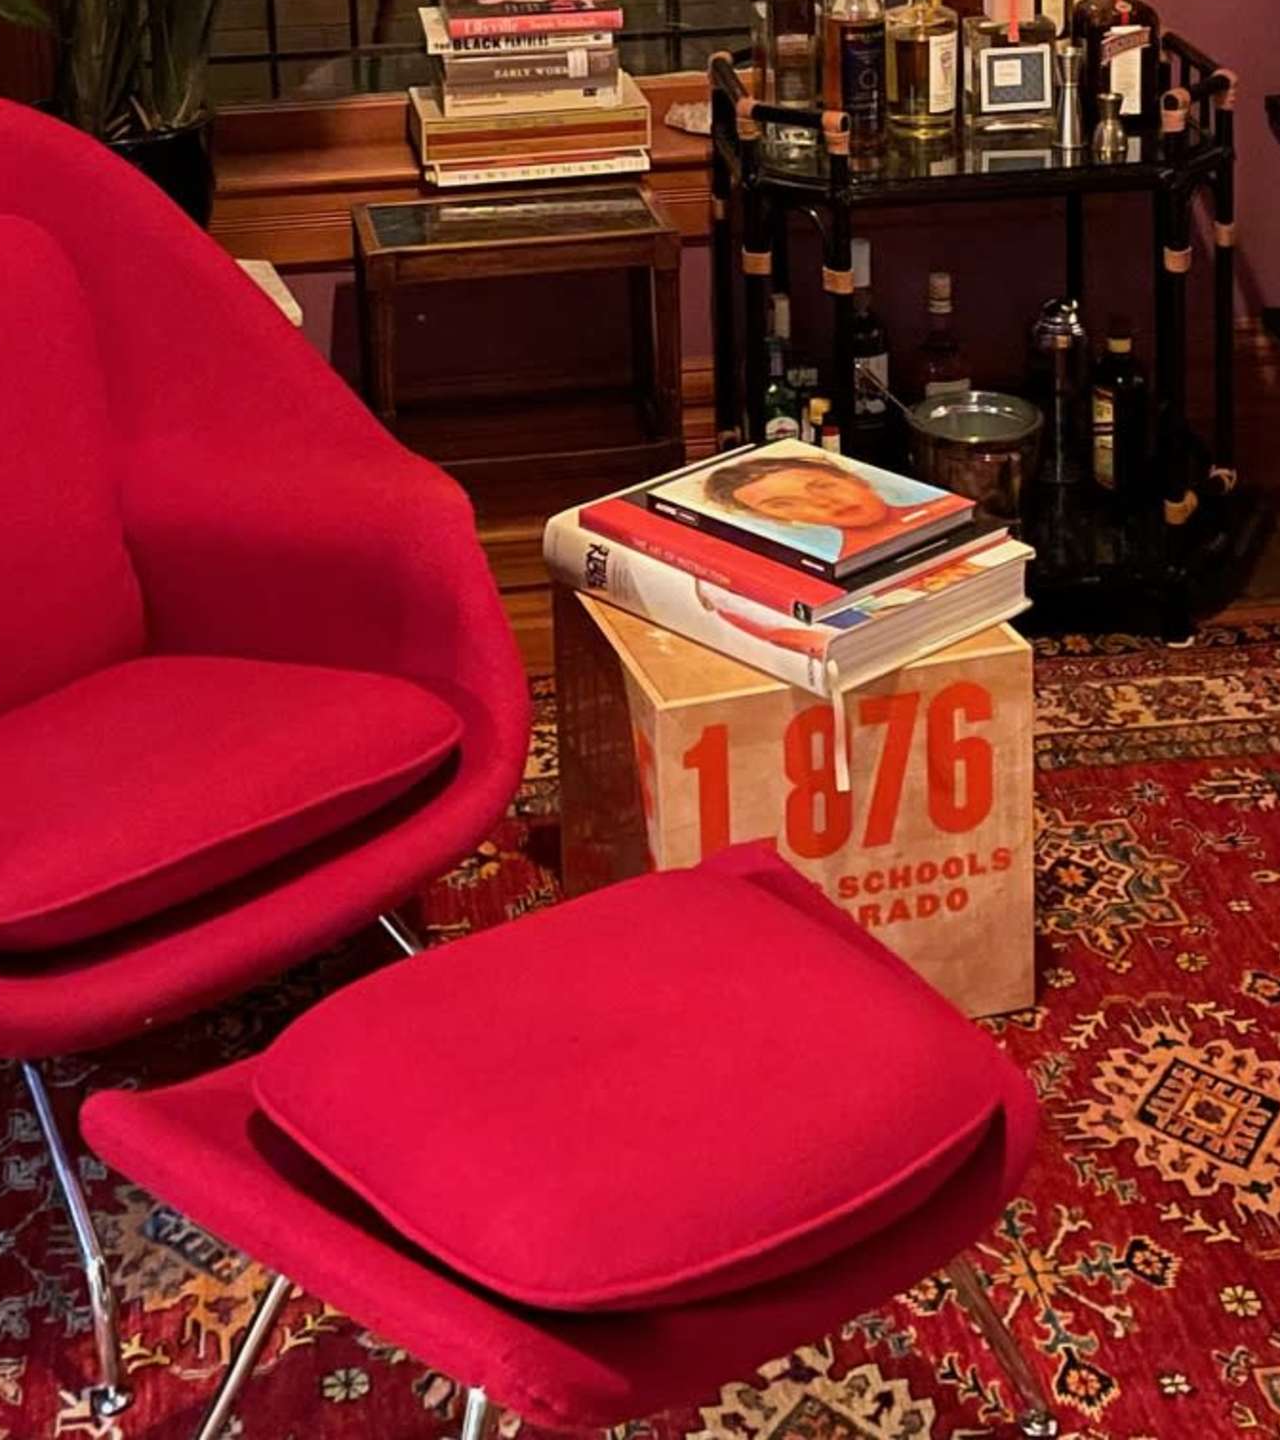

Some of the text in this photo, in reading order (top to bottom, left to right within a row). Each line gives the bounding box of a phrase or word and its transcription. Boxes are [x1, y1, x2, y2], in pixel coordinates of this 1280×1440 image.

[453, 37, 501, 51] BLACK
[682, 681, 994, 862] 1876
[837, 847, 1014, 900] SCHOOLS
[848, 886, 969, 929] RADO
